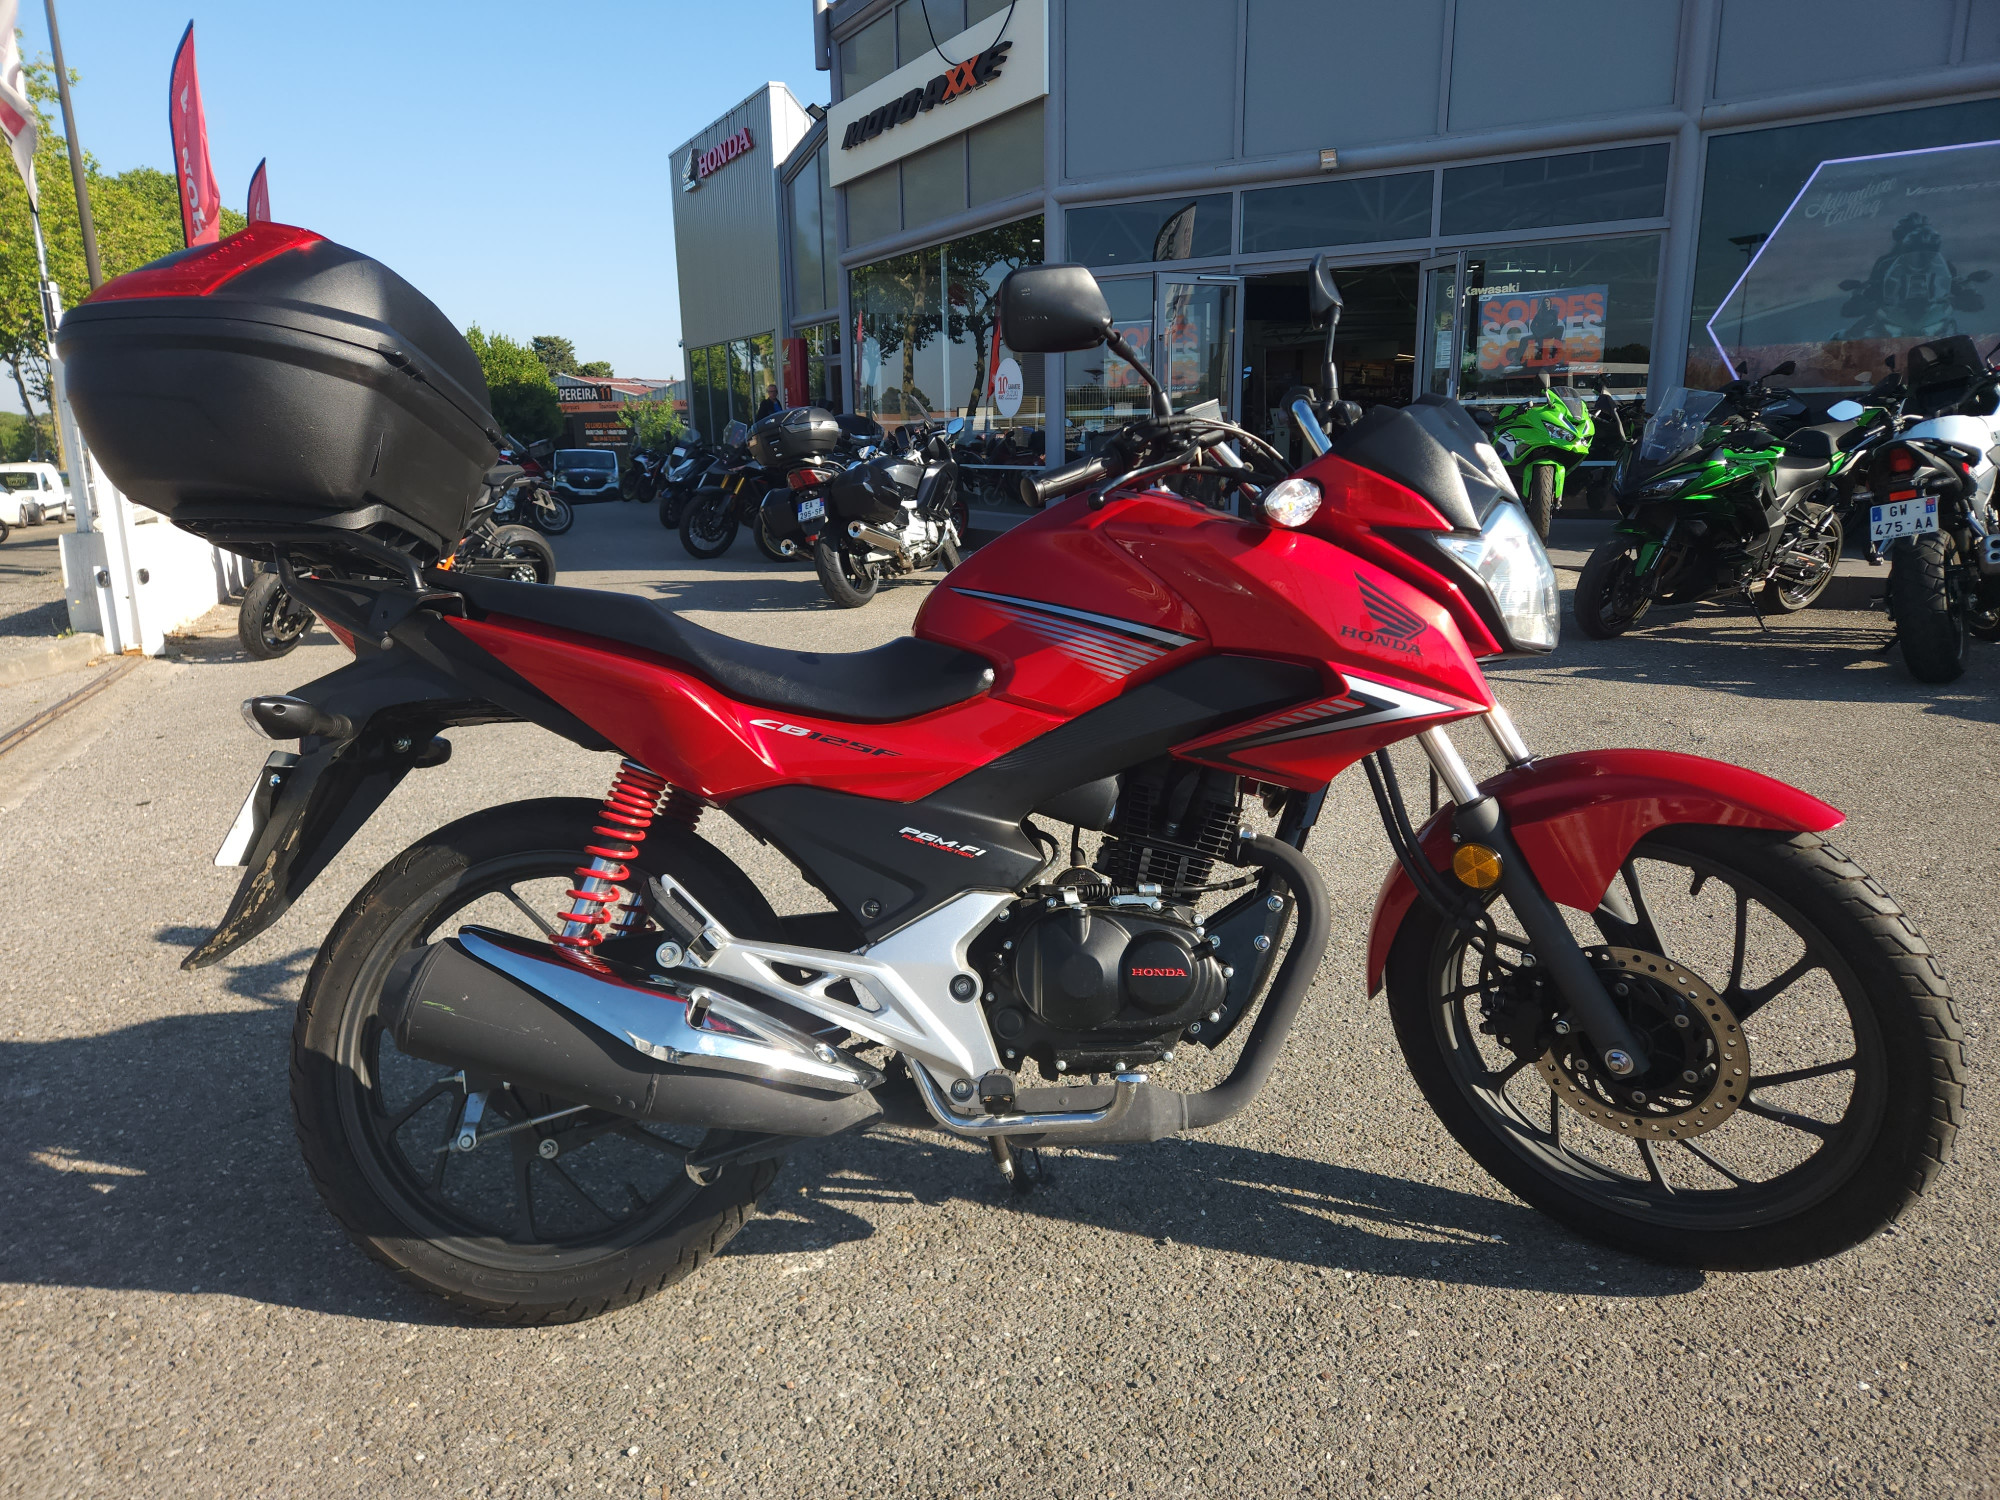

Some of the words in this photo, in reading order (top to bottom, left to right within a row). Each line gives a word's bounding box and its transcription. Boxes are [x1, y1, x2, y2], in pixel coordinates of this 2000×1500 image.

[698, 127, 754, 178] HONDA
[1465, 283, 1520, 296] Kawasaki
[559, 387, 599, 401] PEREIRA
[600, 386, 611, 400] 11
[998, 376, 1008, 395] 10
[805, 500, 813, 510] EA
[1889, 504, 1907, 517] GW
[1875, 516, 1933, 536] 475-AA
[1340, 625, 1424, 656] HONDA
[750, 719, 903, 757] CB125F
[901, 833, 925, 845] FUEL
[927, 841, 975, 859] INJECTION
[1131, 967, 1188, 977] HONDA
